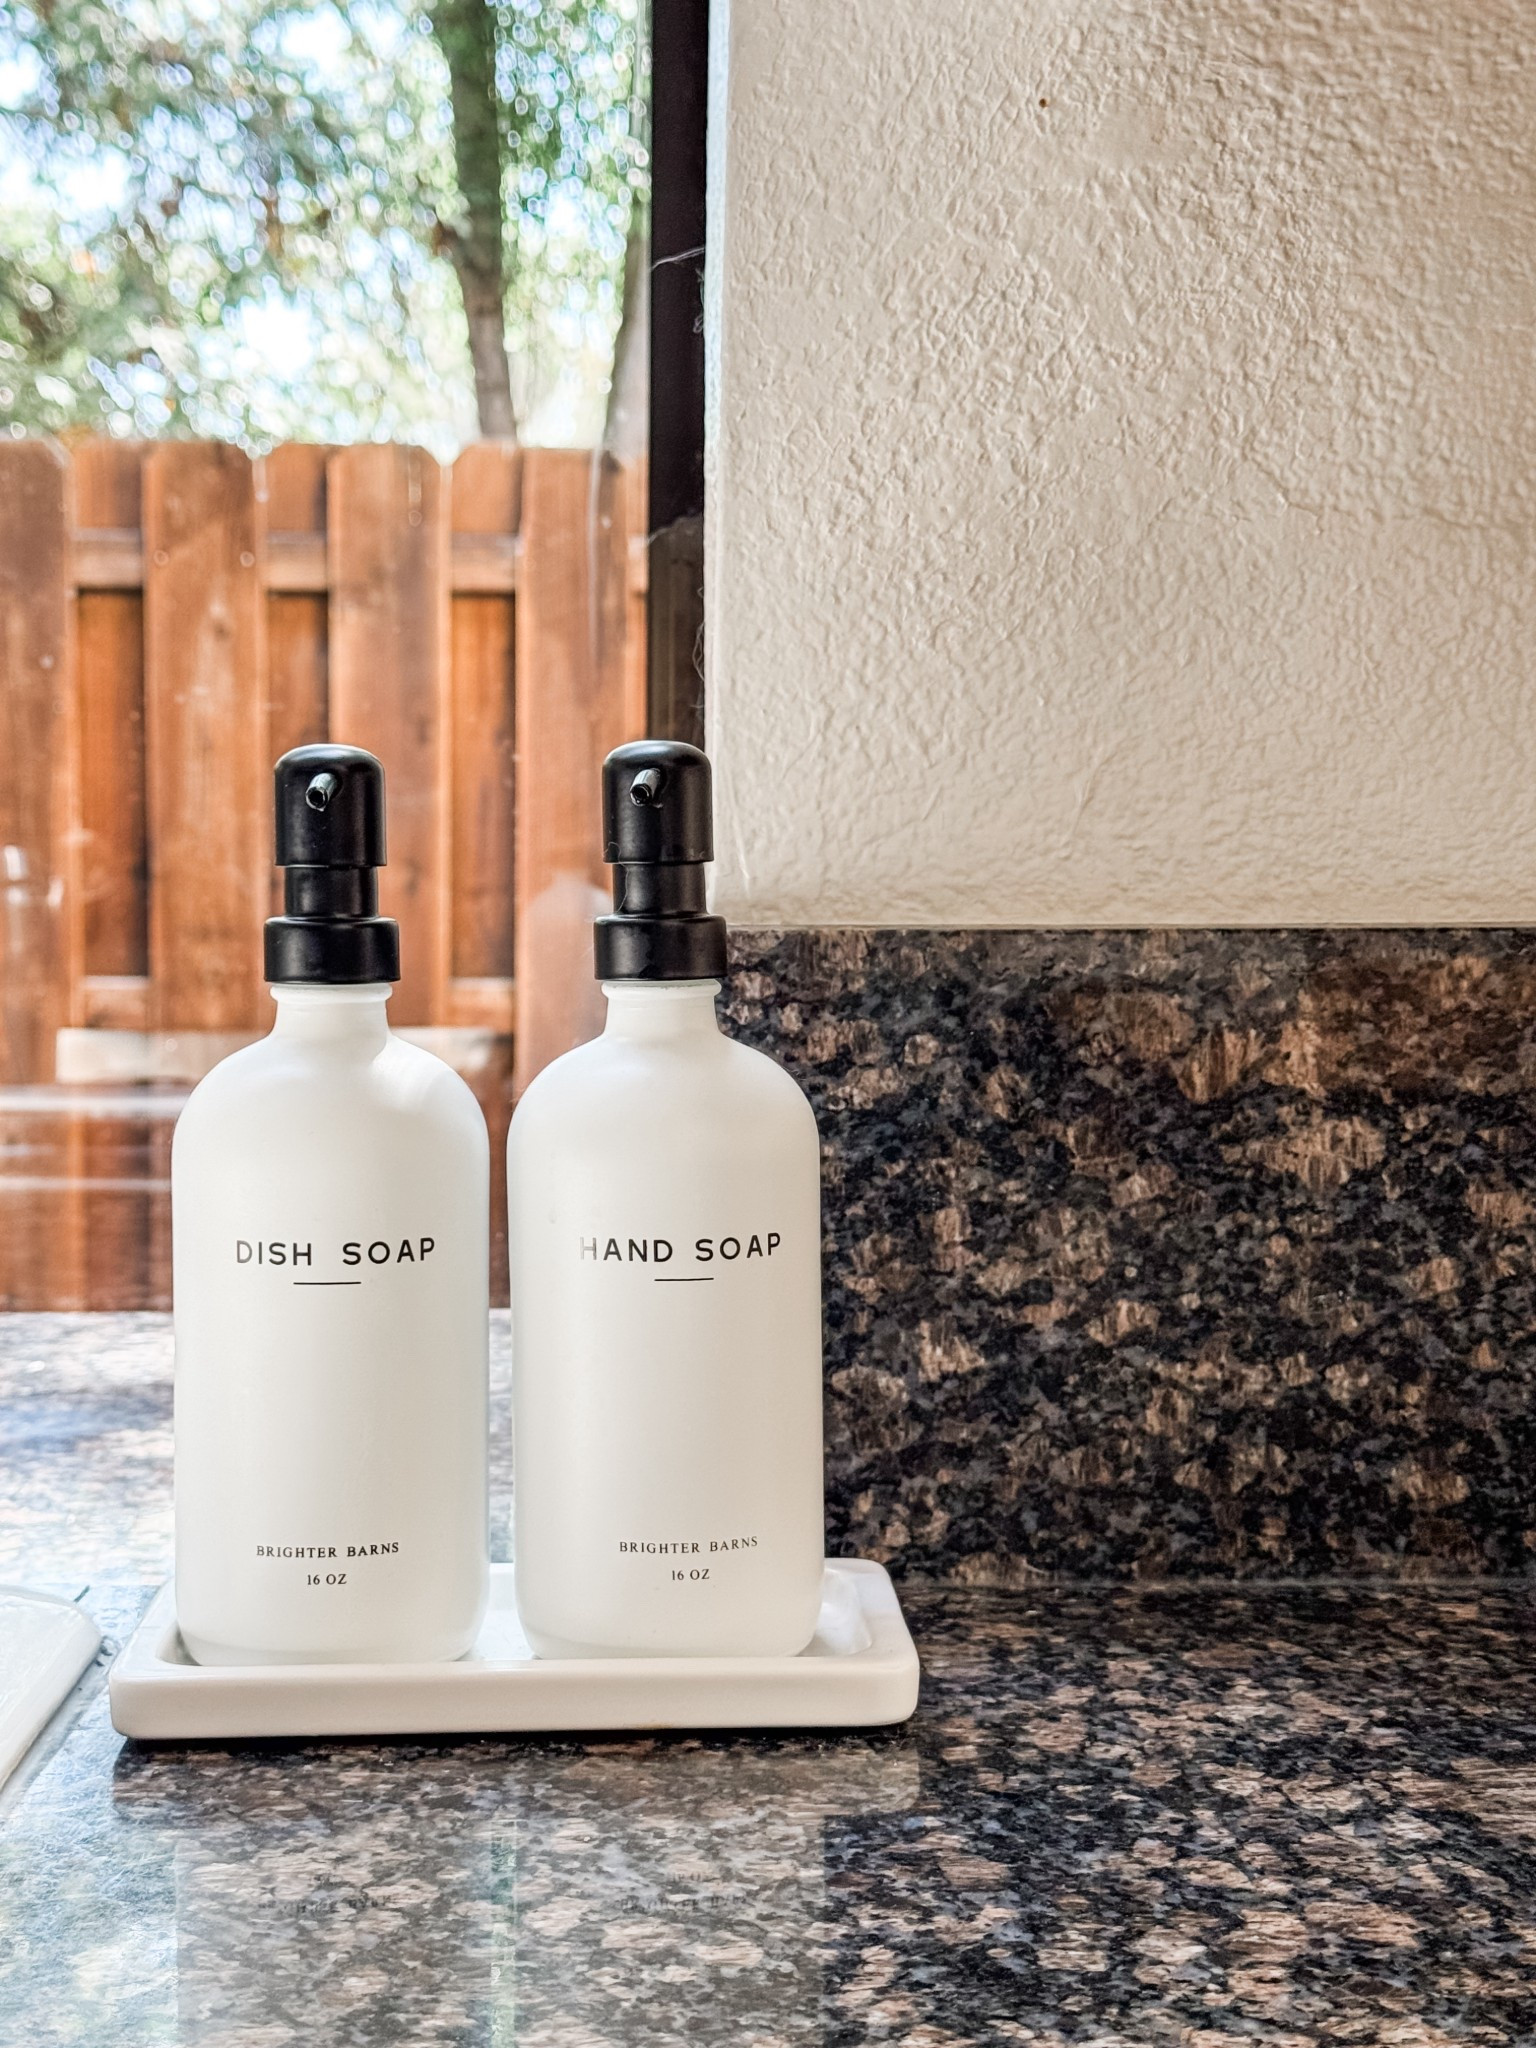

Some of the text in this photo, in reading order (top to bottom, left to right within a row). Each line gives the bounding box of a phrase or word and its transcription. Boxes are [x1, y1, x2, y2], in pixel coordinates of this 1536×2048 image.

[236, 1236, 436, 1266] DISH SOAP
[578, 1232, 782, 1263] HAND SOAP
[256, 1542, 399, 1558] BRIGHTER BARNS
[619, 1536, 758, 1554] BRIGHTER BARNS
[306, 1573, 347, 1586] 16 OZ
[671, 1568, 710, 1581] 16 OZ
